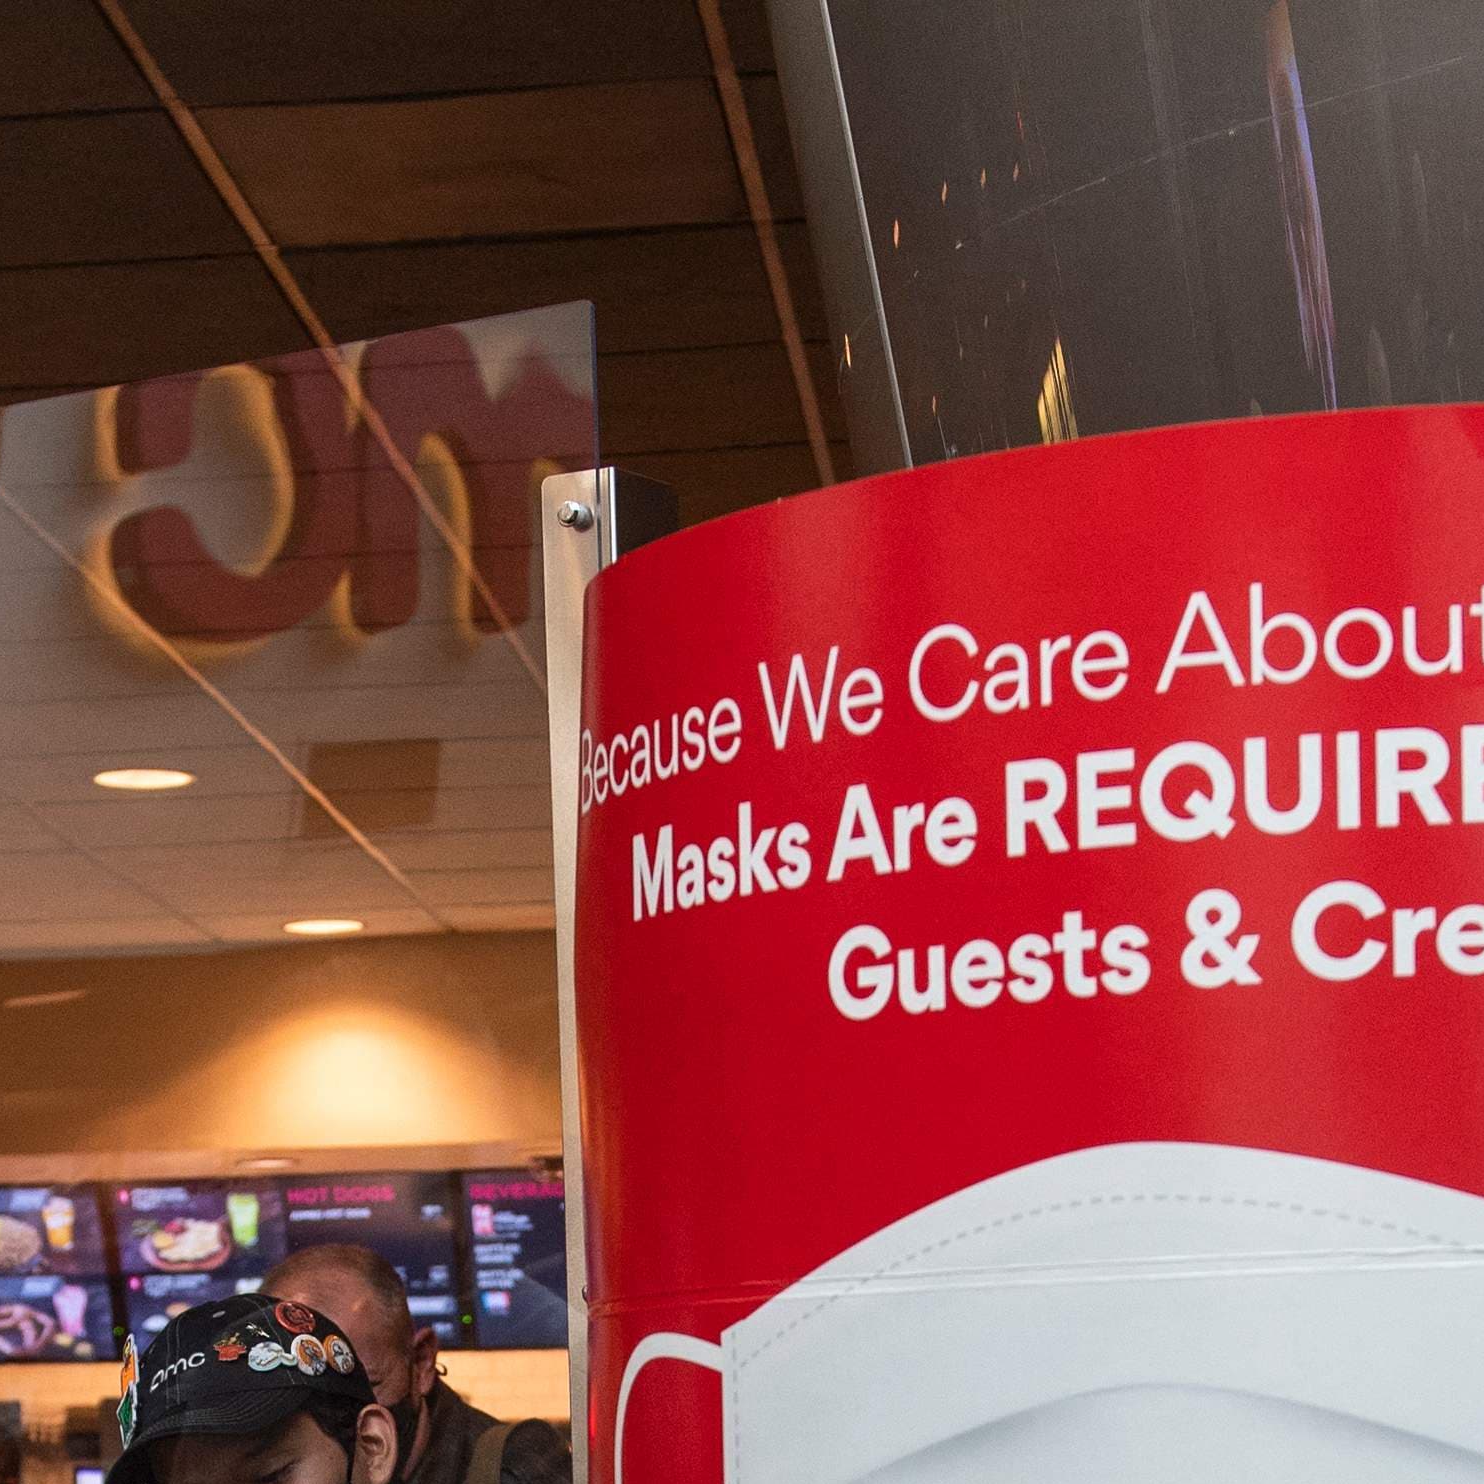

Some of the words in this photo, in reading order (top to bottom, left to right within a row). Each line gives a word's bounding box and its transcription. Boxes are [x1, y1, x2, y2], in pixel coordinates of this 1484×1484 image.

[582, 698, 741, 814] Because
[758, 646, 883, 750] We
[909, 624, 1129, 721] Care
[633, 802, 811, 921] Masks
[827, 784, 977, 881] Are
[828, 911, 1151, 1020] Guests
[1180, 888, 1263, 989] &
[149, 1352, 205, 1392] amc
